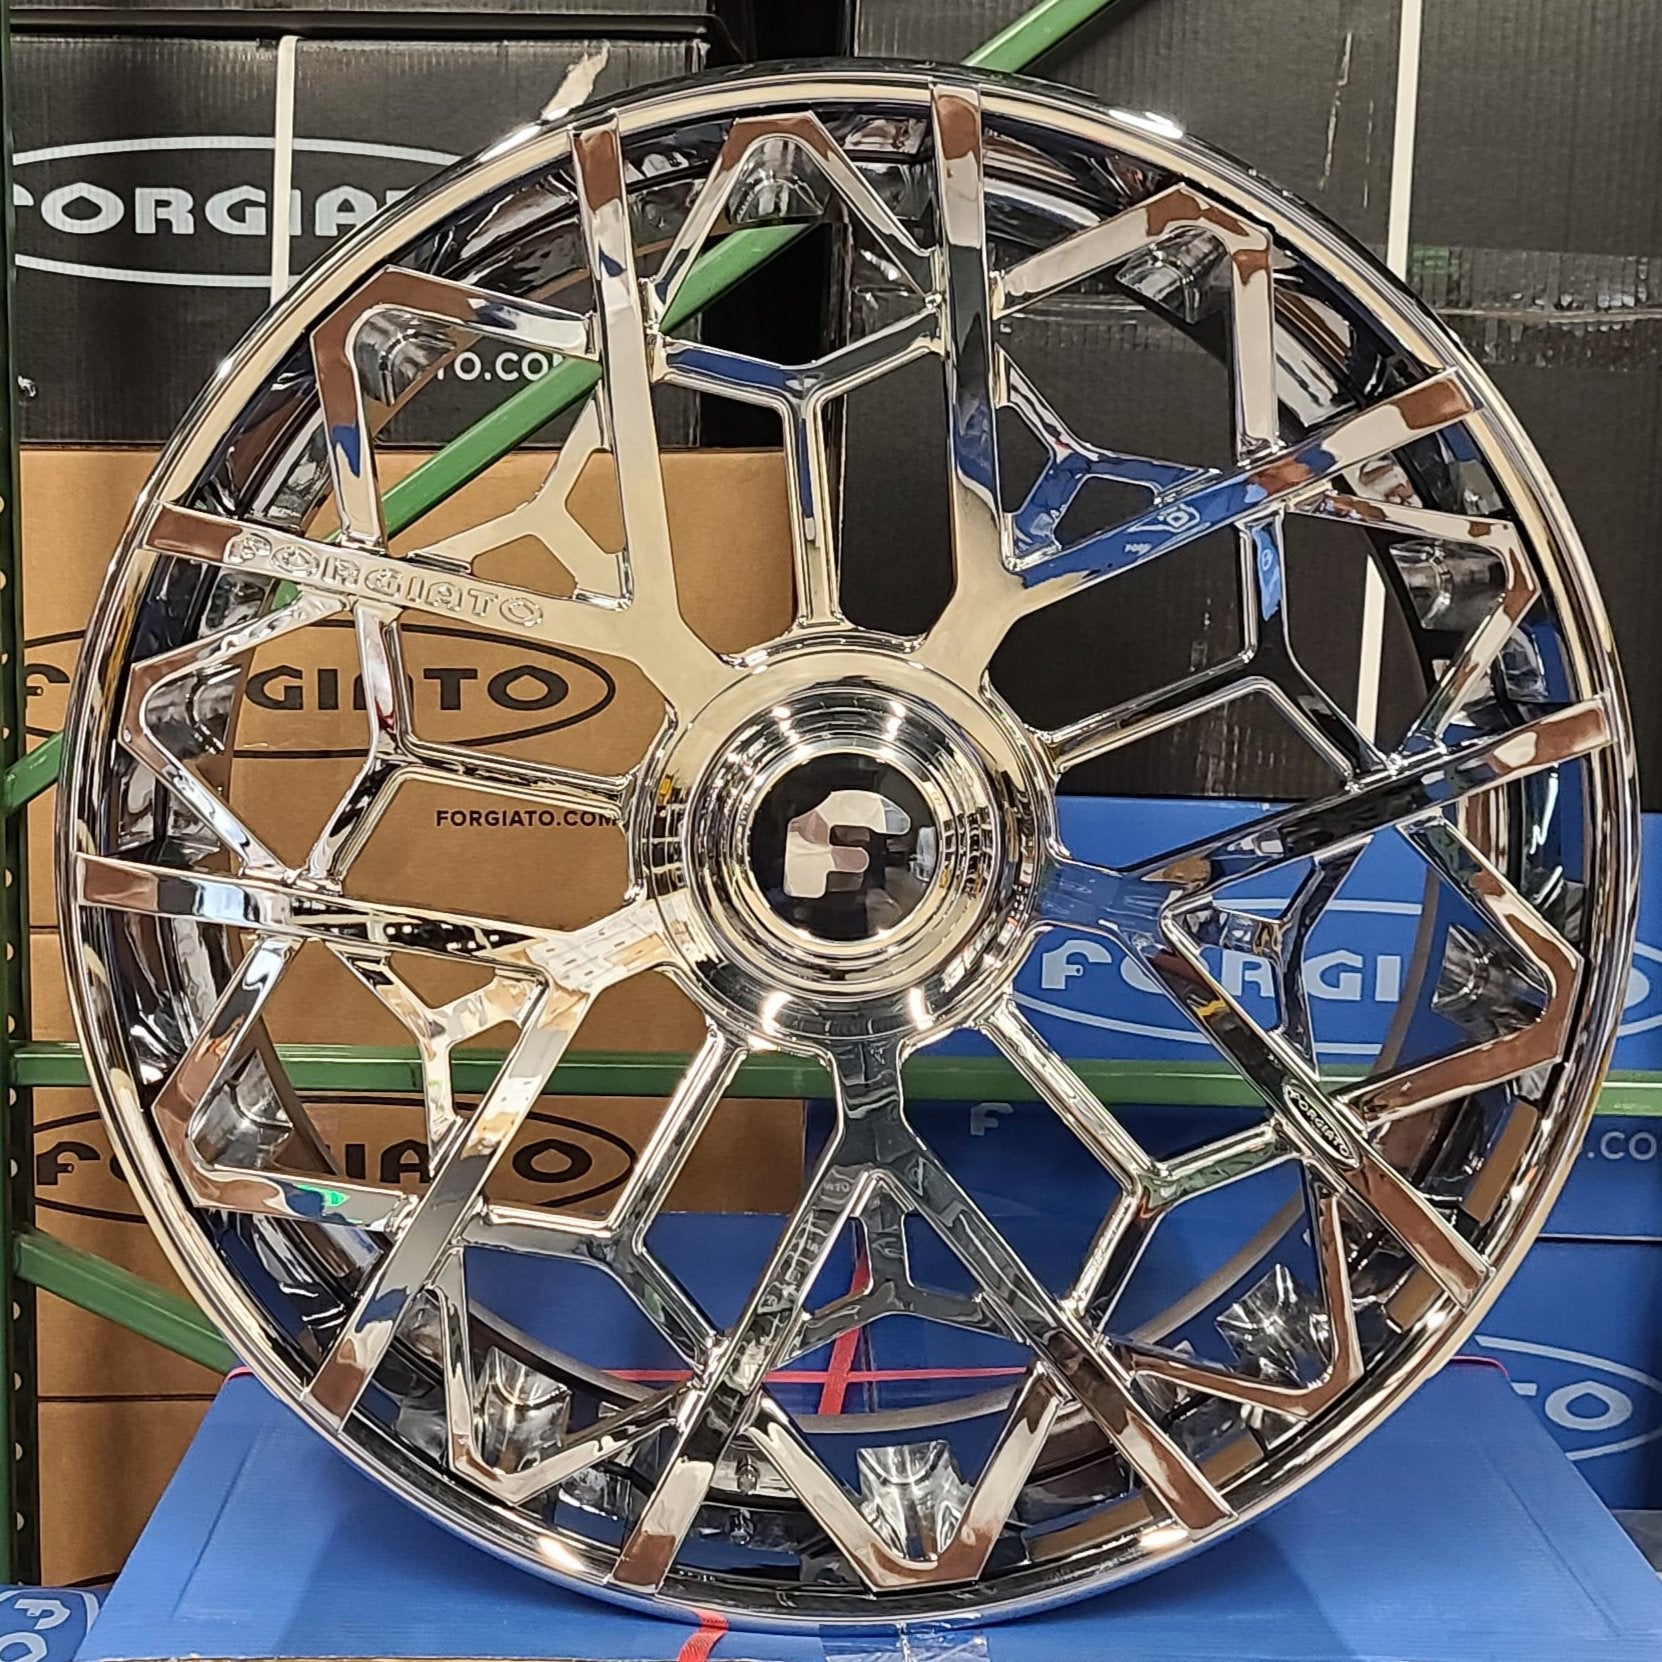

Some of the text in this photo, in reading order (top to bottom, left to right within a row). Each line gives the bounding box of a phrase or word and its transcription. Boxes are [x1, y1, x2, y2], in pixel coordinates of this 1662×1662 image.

[13, 182, 413, 236] ORGIA
[224, 533, 545, 628] FORGIATO
[25, 664, 569, 712] FGITO
[1284, 1085, 1350, 1158] FORGIATO
